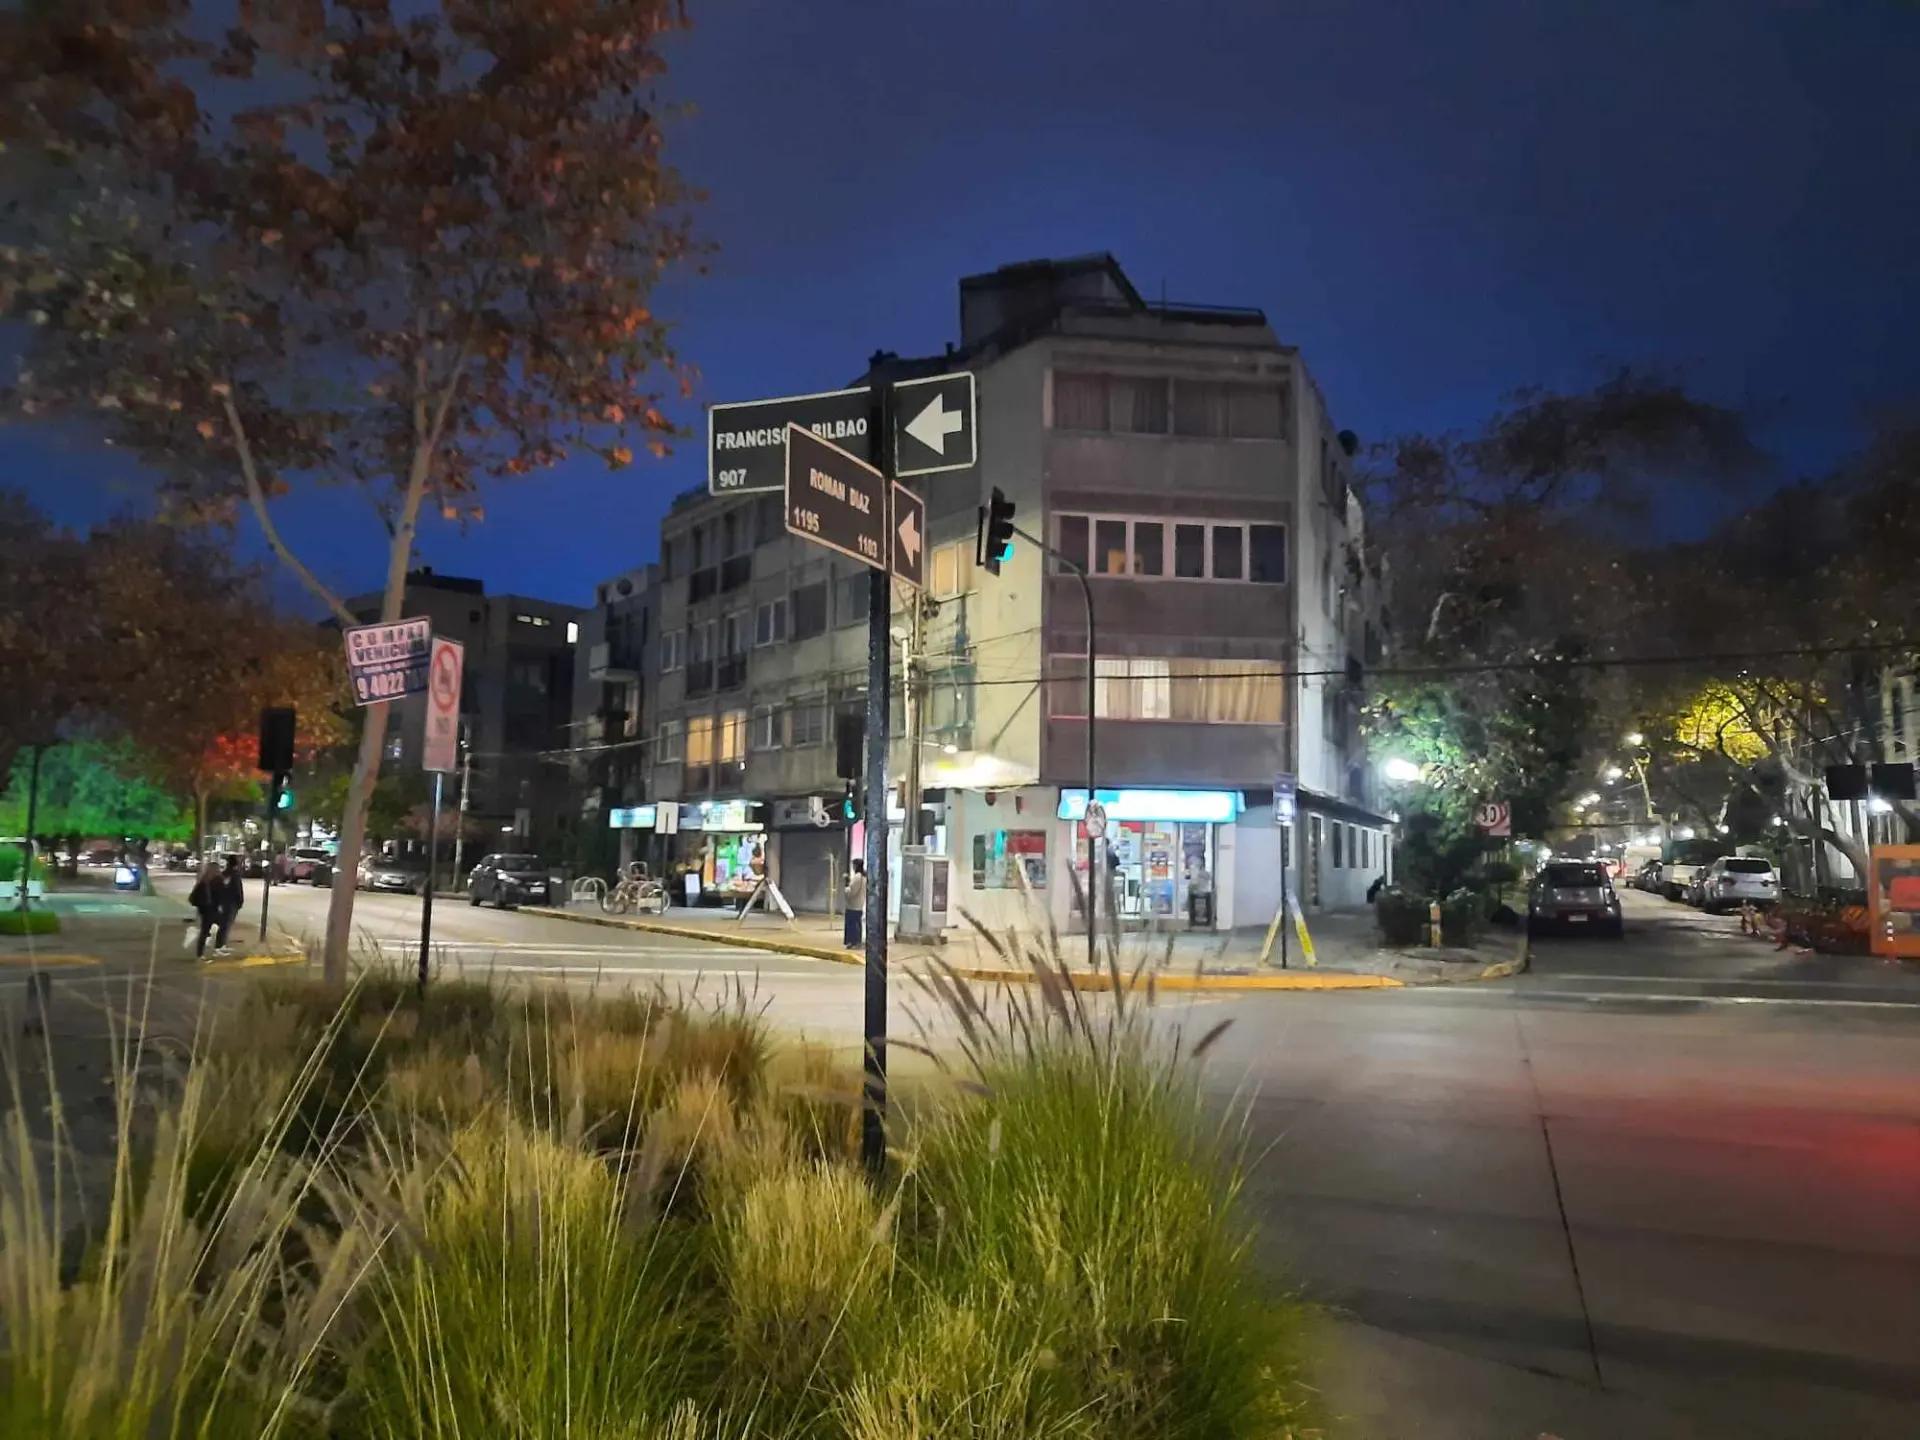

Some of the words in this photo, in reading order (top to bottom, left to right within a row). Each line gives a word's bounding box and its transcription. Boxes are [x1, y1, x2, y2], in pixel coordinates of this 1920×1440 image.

[716, 427, 788, 450] FRANCISC
[811, 417, 868, 440] BILBAO
[718, 468, 747, 488] 907
[810, 467, 845, 502] ROMAN
[849, 487, 870, 514] DIAZ
[794, 506, 820, 533] 1195
